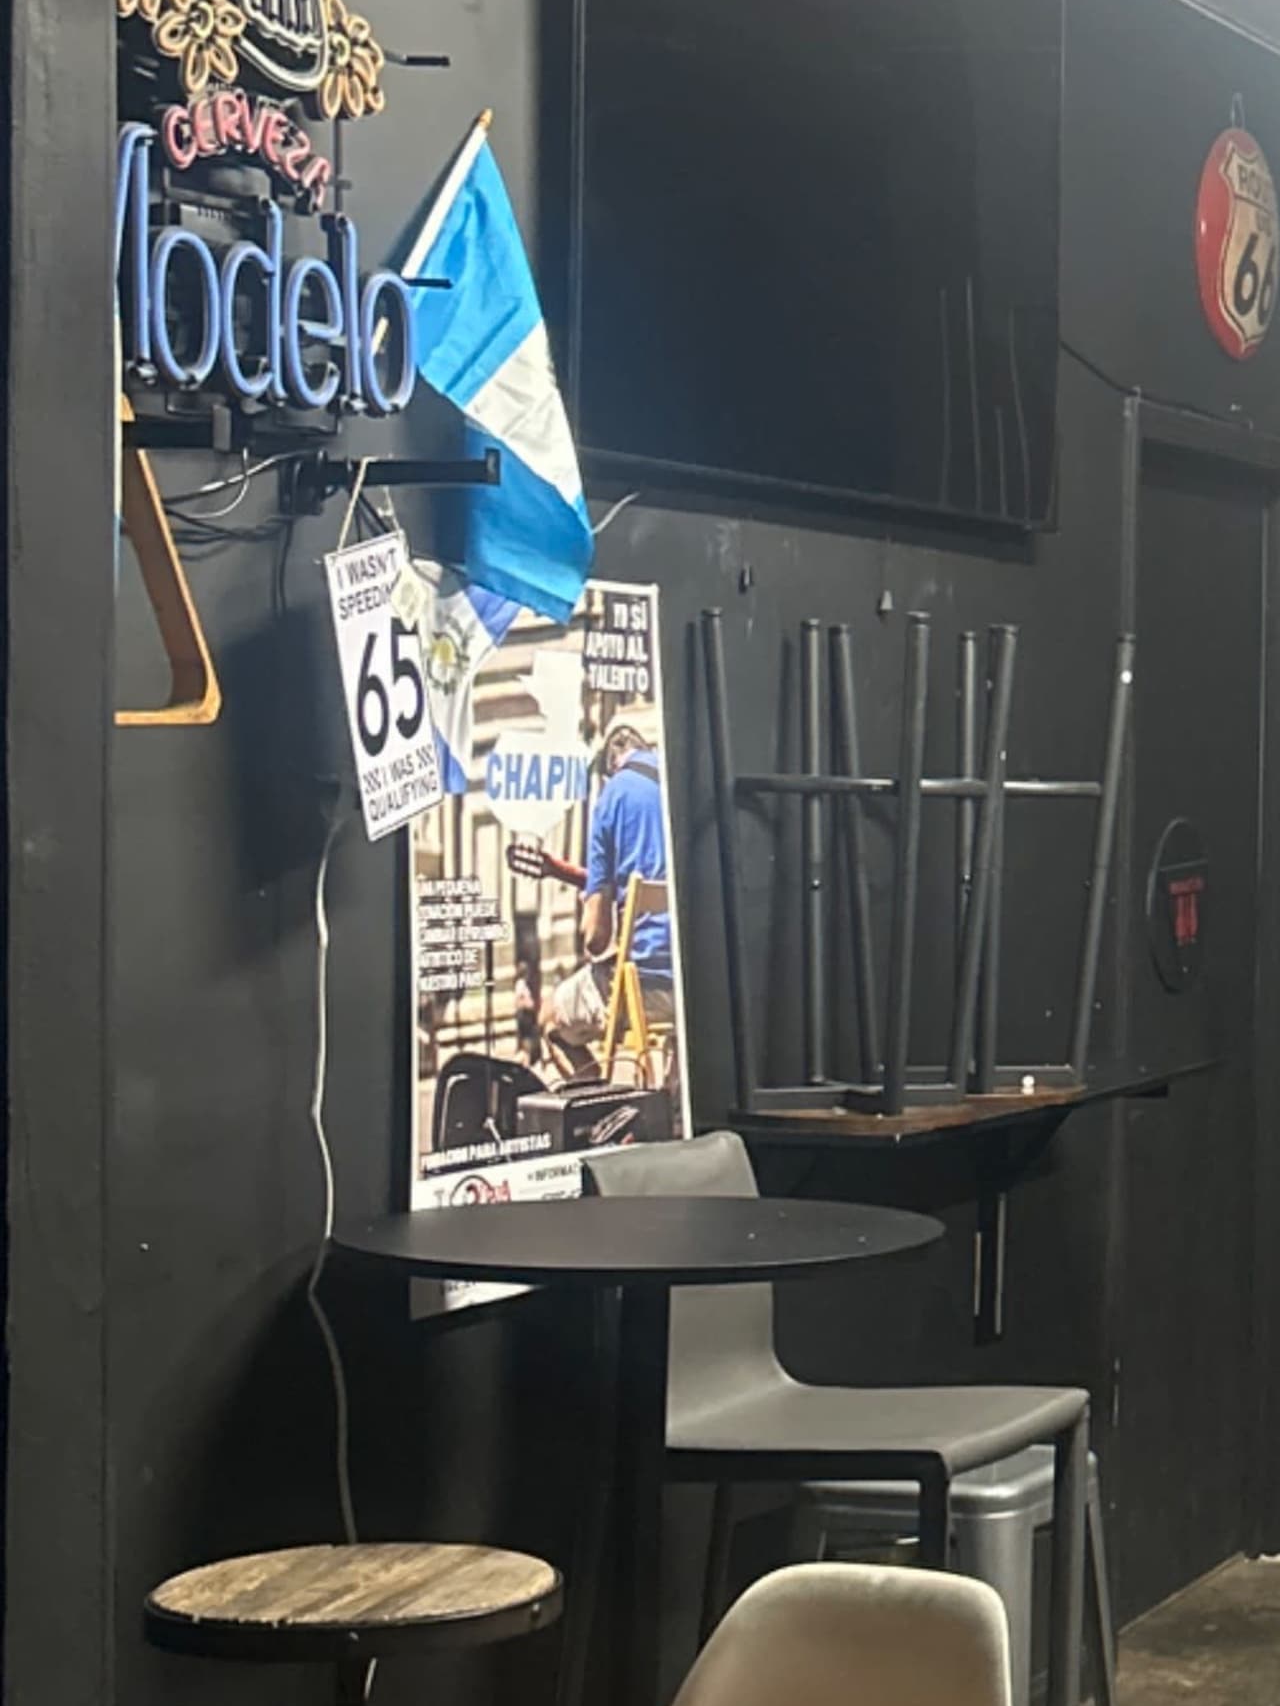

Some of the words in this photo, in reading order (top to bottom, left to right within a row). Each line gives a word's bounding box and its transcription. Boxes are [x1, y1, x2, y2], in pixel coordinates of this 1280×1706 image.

[163, 90, 331, 211] CERVEZA
[1234, 232, 1276, 326] 66
[339, 580, 396, 620] SPEEDIN
[626, 635, 649, 663] AL
[357, 616, 425, 757] 65
[588, 663, 649, 693] TALENTO
[368, 770, 437, 822] QUALIFYING
[485, 753, 589, 801] CHAPIN
